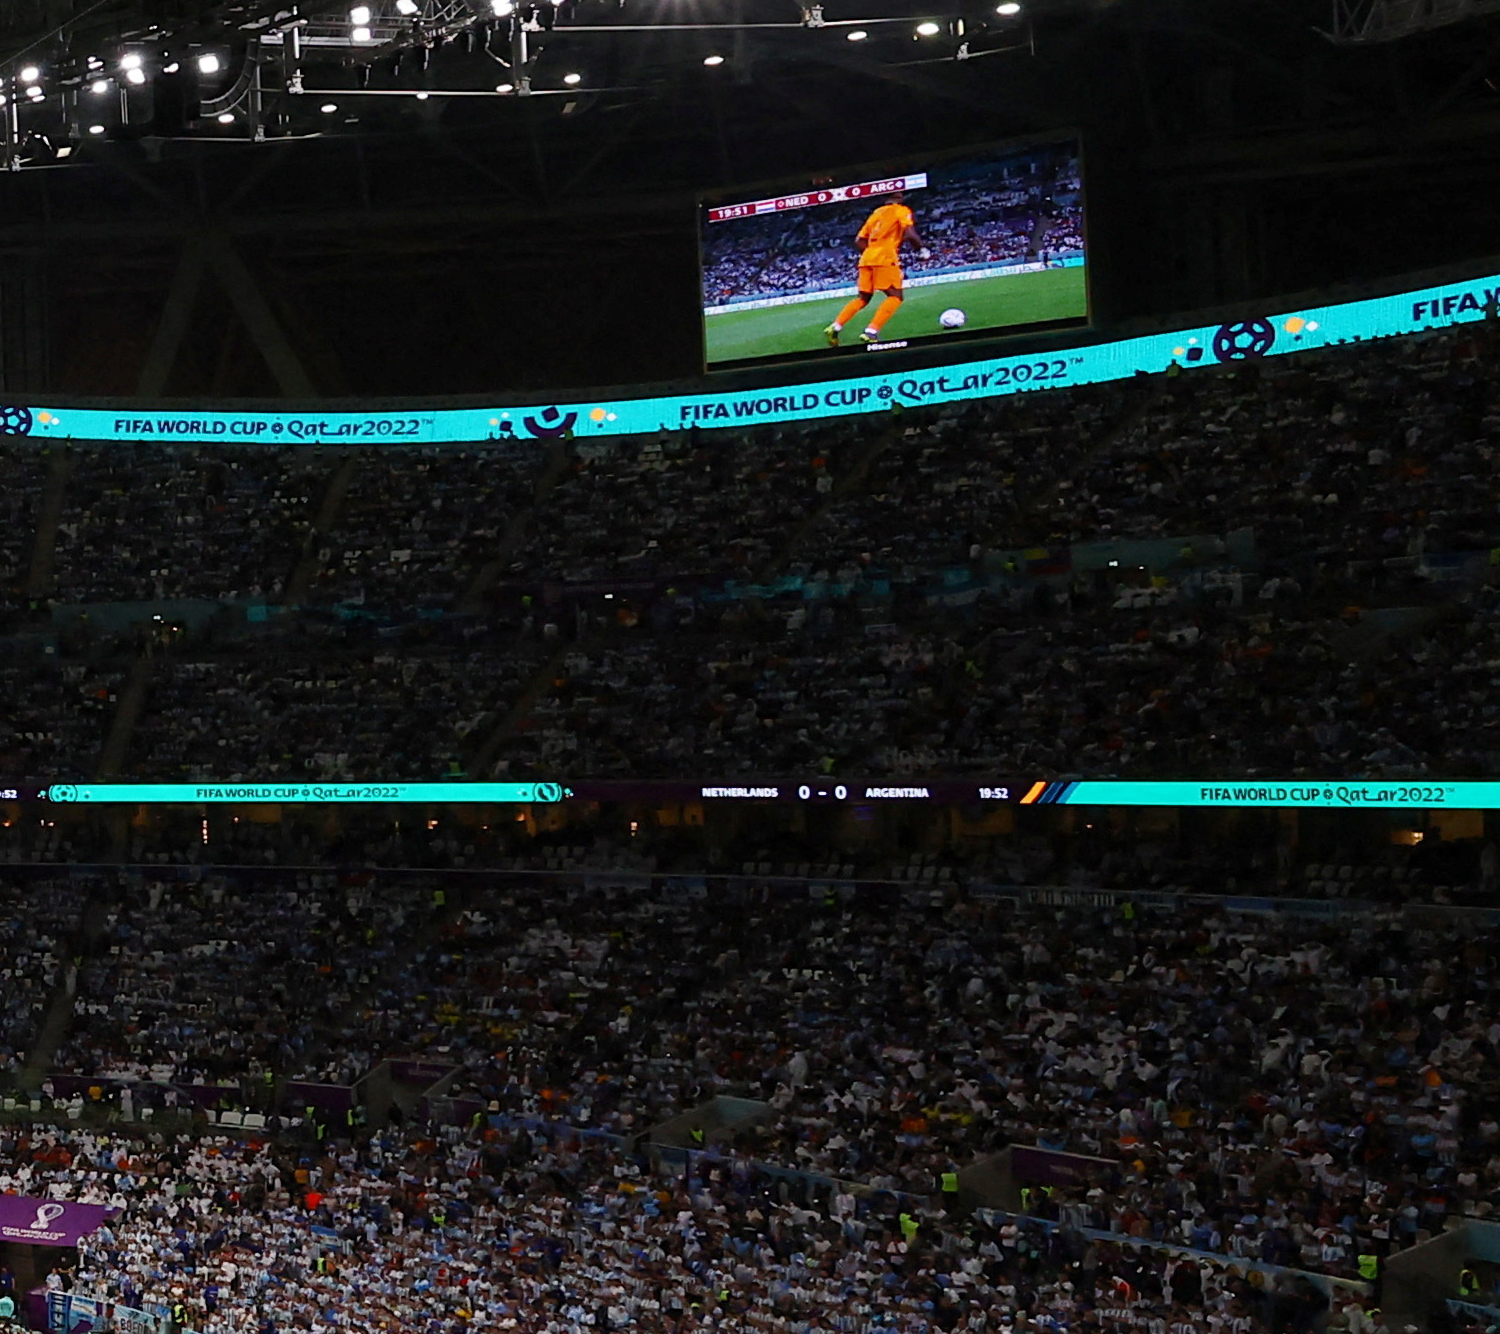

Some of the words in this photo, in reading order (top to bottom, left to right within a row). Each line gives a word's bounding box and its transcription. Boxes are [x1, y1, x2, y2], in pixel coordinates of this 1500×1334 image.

[718, 205, 748, 219] 19:51
[785, 195, 809, 208] NED
[870, 179, 895, 193] ARG
[1413, 293, 1474, 321] FIFA
[681, 403, 730, 420] FIFA
[734, 394, 819, 417] WORLD
[824, 388, 871, 406] CUP
[115, 420, 154, 433] FIFA
[158, 420, 226, 434] WORLD
[230, 421, 267, 435] CUP
[196, 788, 223, 798] FIFA
[224, 788, 271, 798] WORLD
[273, 788, 299, 798] CUP
[701, 787, 779, 798] NETHERLANDS
[798, 785, 811, 800] 0
[834, 785, 847, 800] 0
[865, 787, 930, 798] ARGENTINA
[978, 787, 1009, 799] 19:52
[1200, 787, 1232, 801] FIFA
[1232, 787, 1287, 802] WORLD
[1289, 787, 1320, 802] CUP
